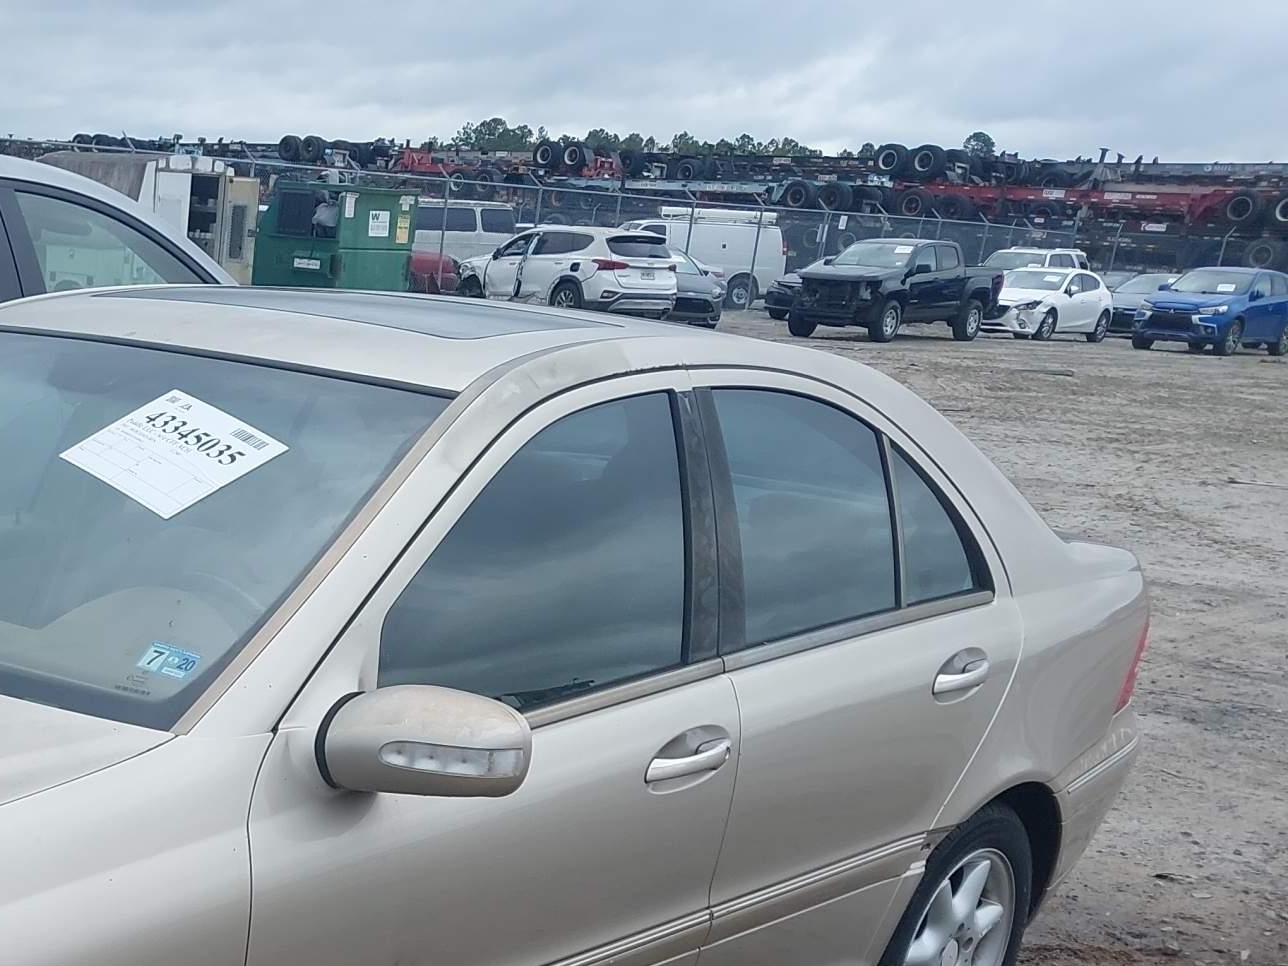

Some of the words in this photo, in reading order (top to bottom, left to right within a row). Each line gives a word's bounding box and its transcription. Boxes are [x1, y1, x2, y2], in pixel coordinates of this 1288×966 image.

[145, 411, 246, 466] 43345035
[146, 649, 166, 666] 7
[176, 657, 196, 672] 20
